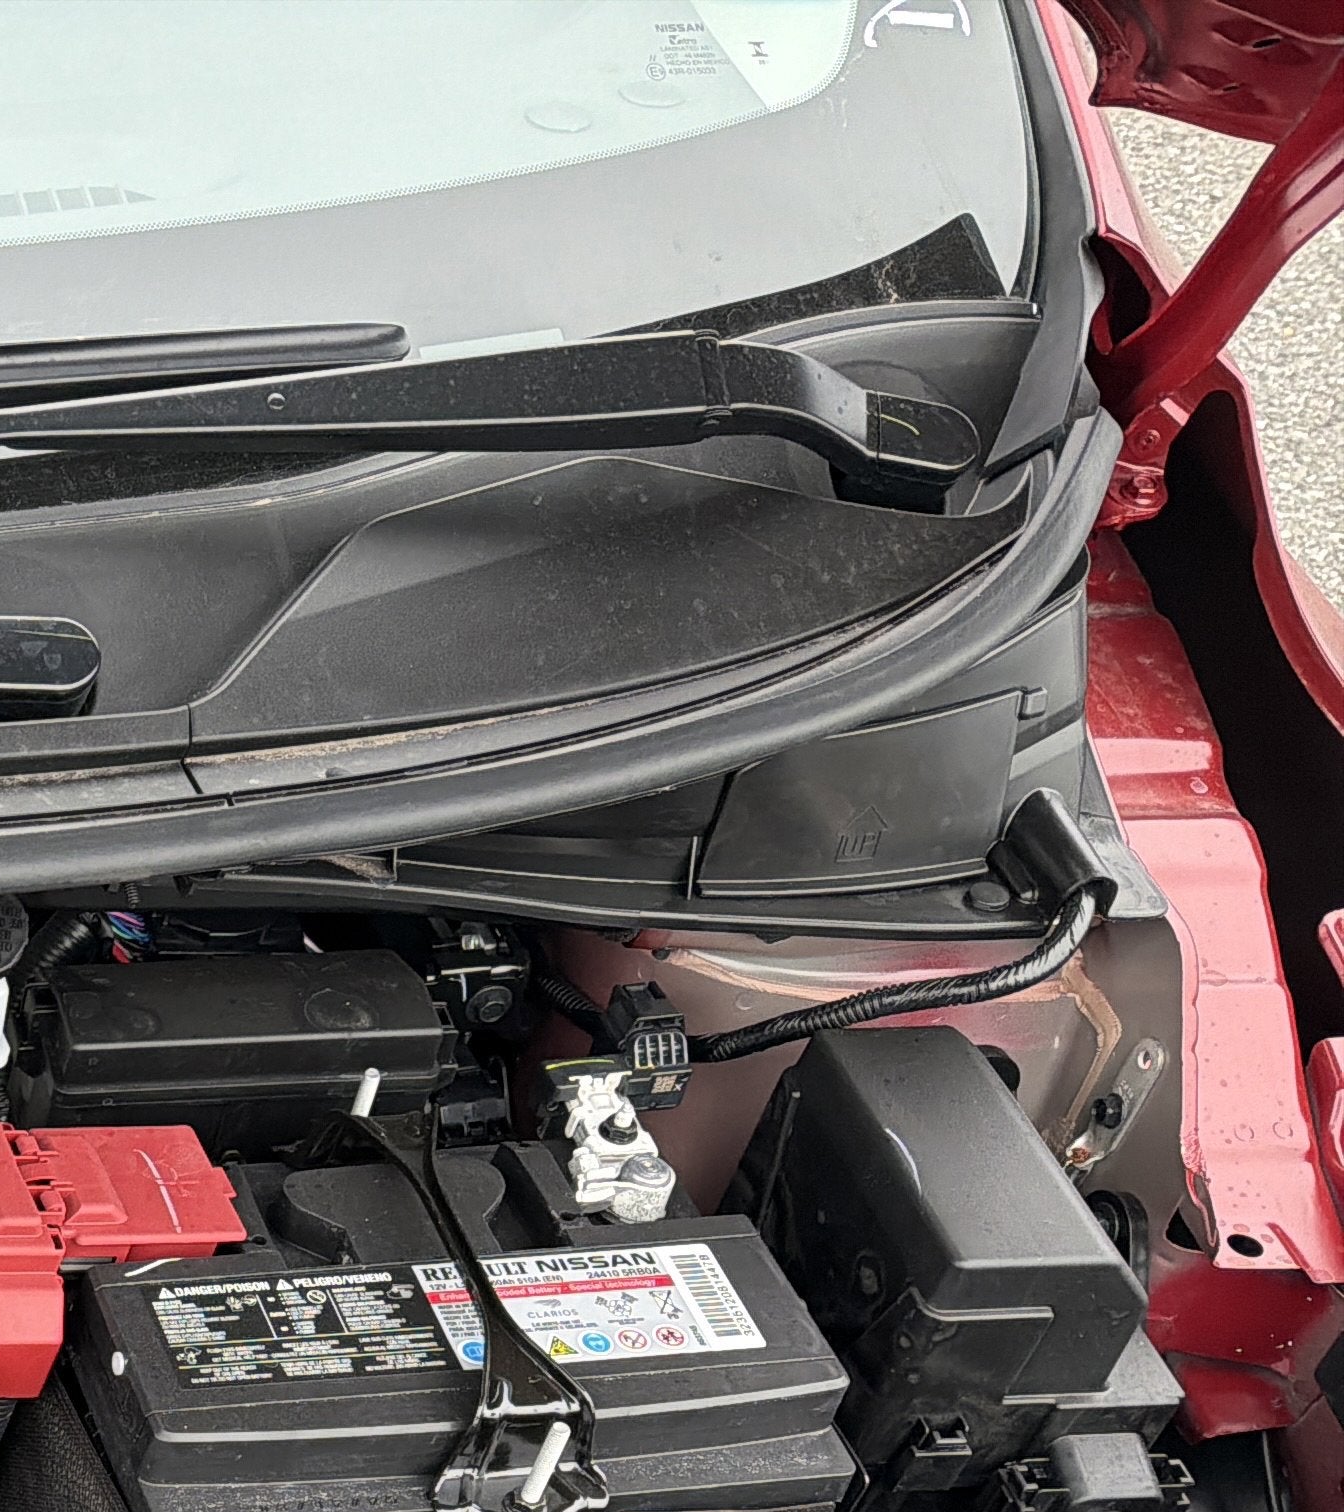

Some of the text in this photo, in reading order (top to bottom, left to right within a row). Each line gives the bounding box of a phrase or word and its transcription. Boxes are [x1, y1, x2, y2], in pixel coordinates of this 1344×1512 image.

[655, 24, 704, 33] NISSAN
[843, 833, 875, 856] UP
[421, 1251, 657, 1281] REULT NISSAN
[292, 1272, 393, 1288] PELIGRO/VENENO
[586, 1270, 620, 1279] 24410
[174, 1281, 271, 1297] DANGER/POISON
[605, 1279, 657, 1290] Technology
[527, 1308, 579, 1319] CLARIOS
